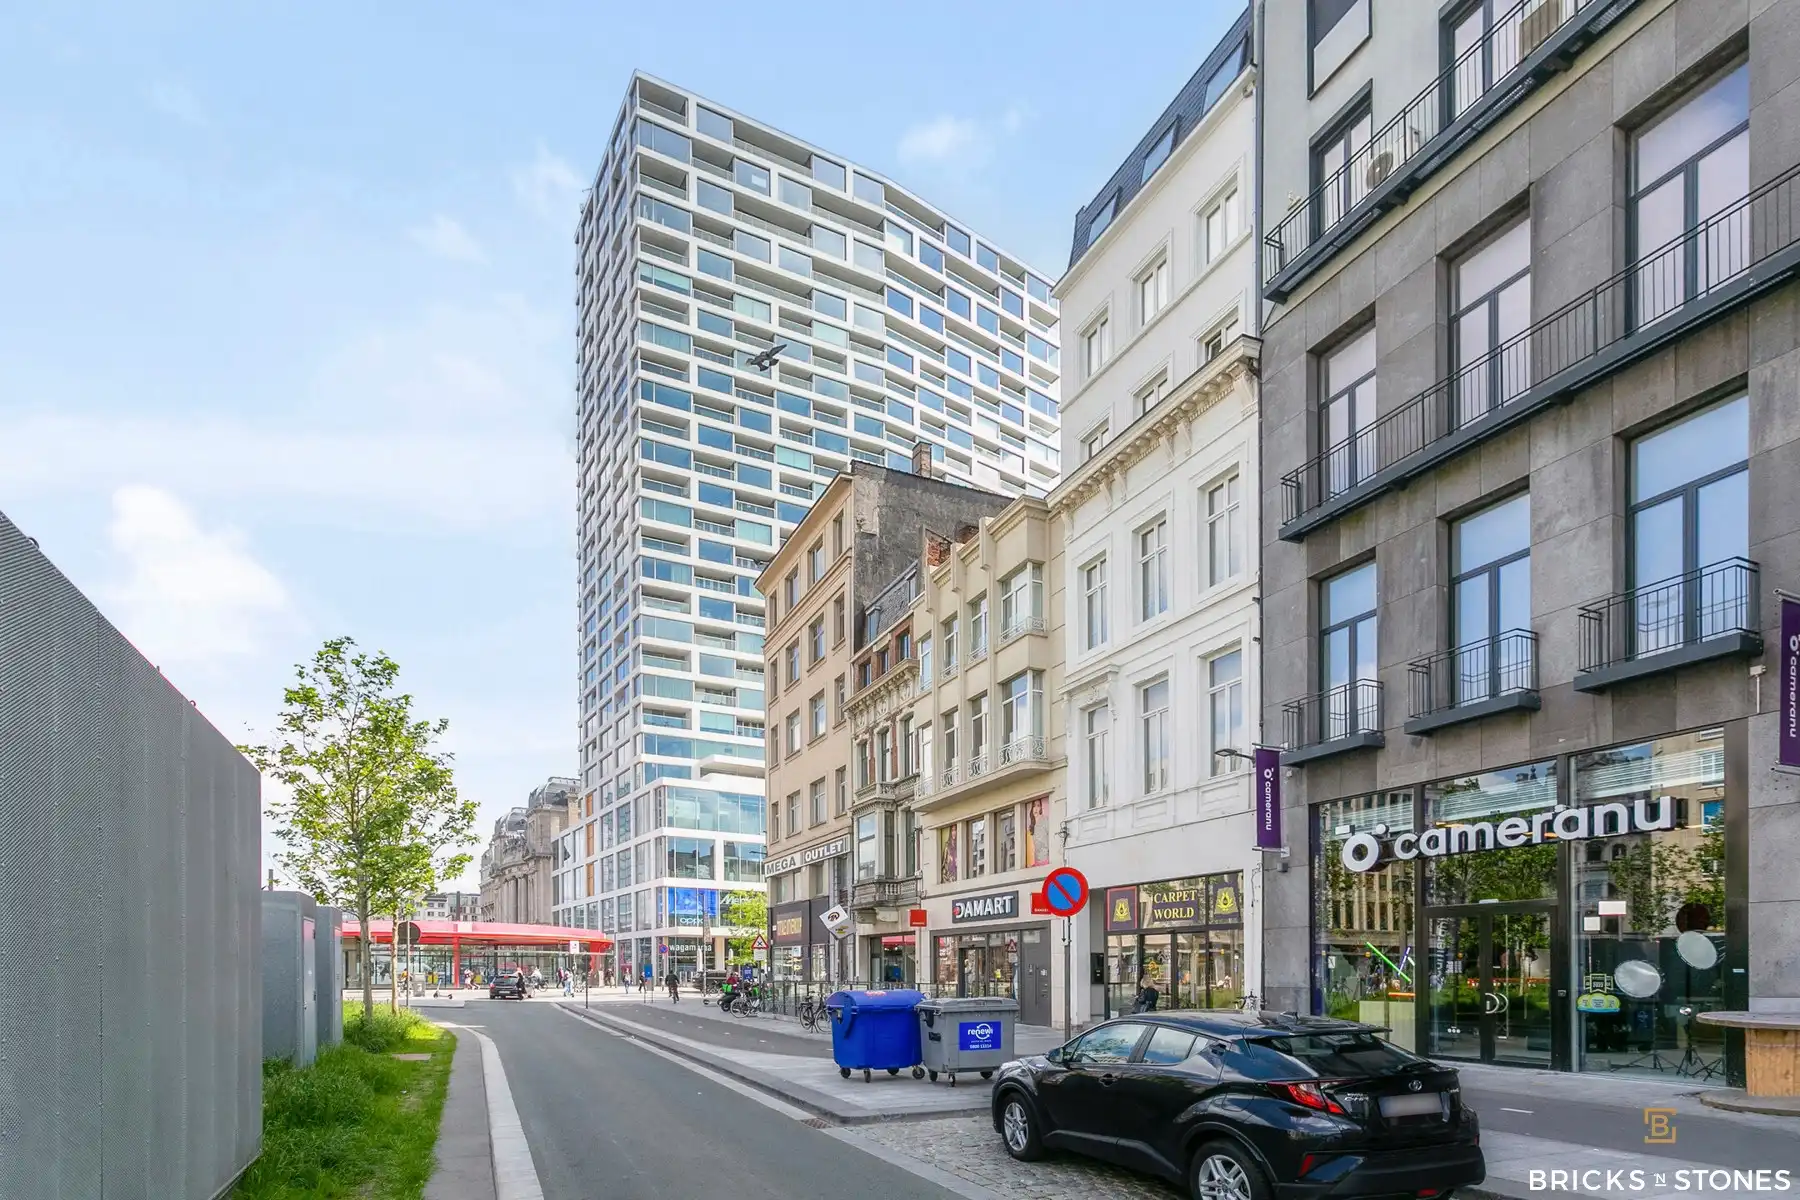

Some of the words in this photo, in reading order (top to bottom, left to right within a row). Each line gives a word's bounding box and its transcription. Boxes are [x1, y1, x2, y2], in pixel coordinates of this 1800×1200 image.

[1789, 656, 1798, 738] cameranu
[1394, 796, 1674, 860] cameranu
[766, 856, 796, 875] MEGA
[804, 840, 843, 862] OUTLET
[954, 895, 1014, 919] DAMART
[1153, 889, 1198, 904] CARPET
[1153, 907, 1195, 920] WORLD
